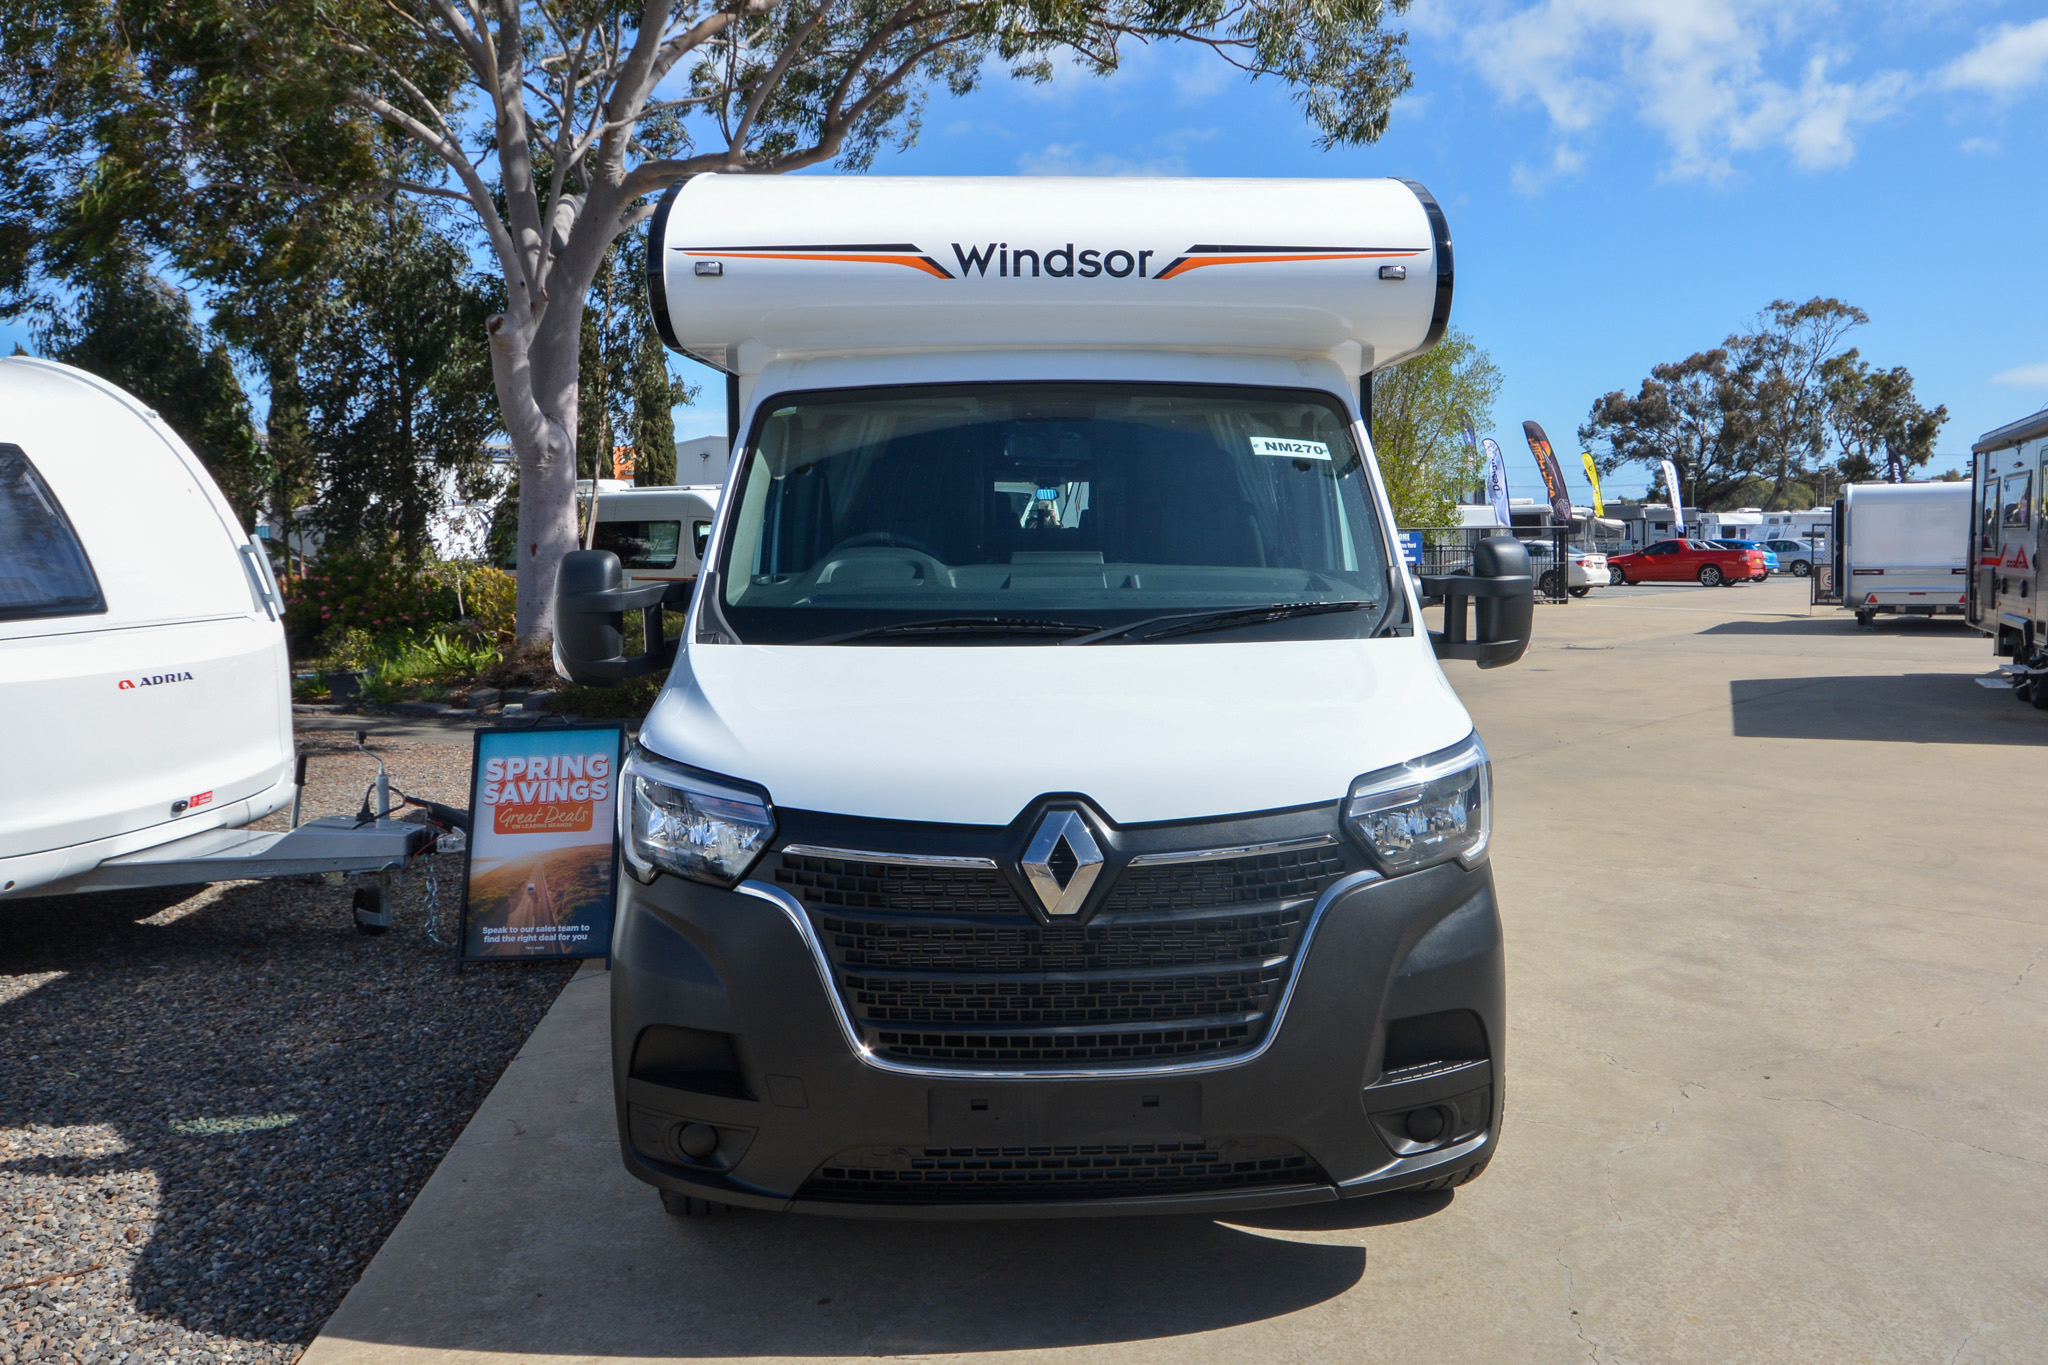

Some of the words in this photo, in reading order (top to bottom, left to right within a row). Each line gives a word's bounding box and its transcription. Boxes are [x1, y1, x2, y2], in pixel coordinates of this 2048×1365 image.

[950, 242, 1154, 278] Windsor
[1264, 441, 1325, 455] NM270
[1893, 462, 1902, 483] APID
[139, 671, 194, 687] ADRIA
[485, 754, 609, 782] SPRING
[483, 780, 608, 805] SAVINGS
[500, 808, 543, 827] Great
[546, 806, 588, 823] Deals
[483, 927, 507, 935] Speak
[509, 926, 519, 934] to
[520, 926, 534, 934] our
[536, 924, 556, 933] sales
[558, 924, 579, 932] team
[484, 935, 501, 943] find
[502, 934, 516, 942] the
[517, 934, 537, 943] right
[538, 932, 557, 941] deal
[558, 932, 571, 940] for
[572, 933, 588, 941] you
